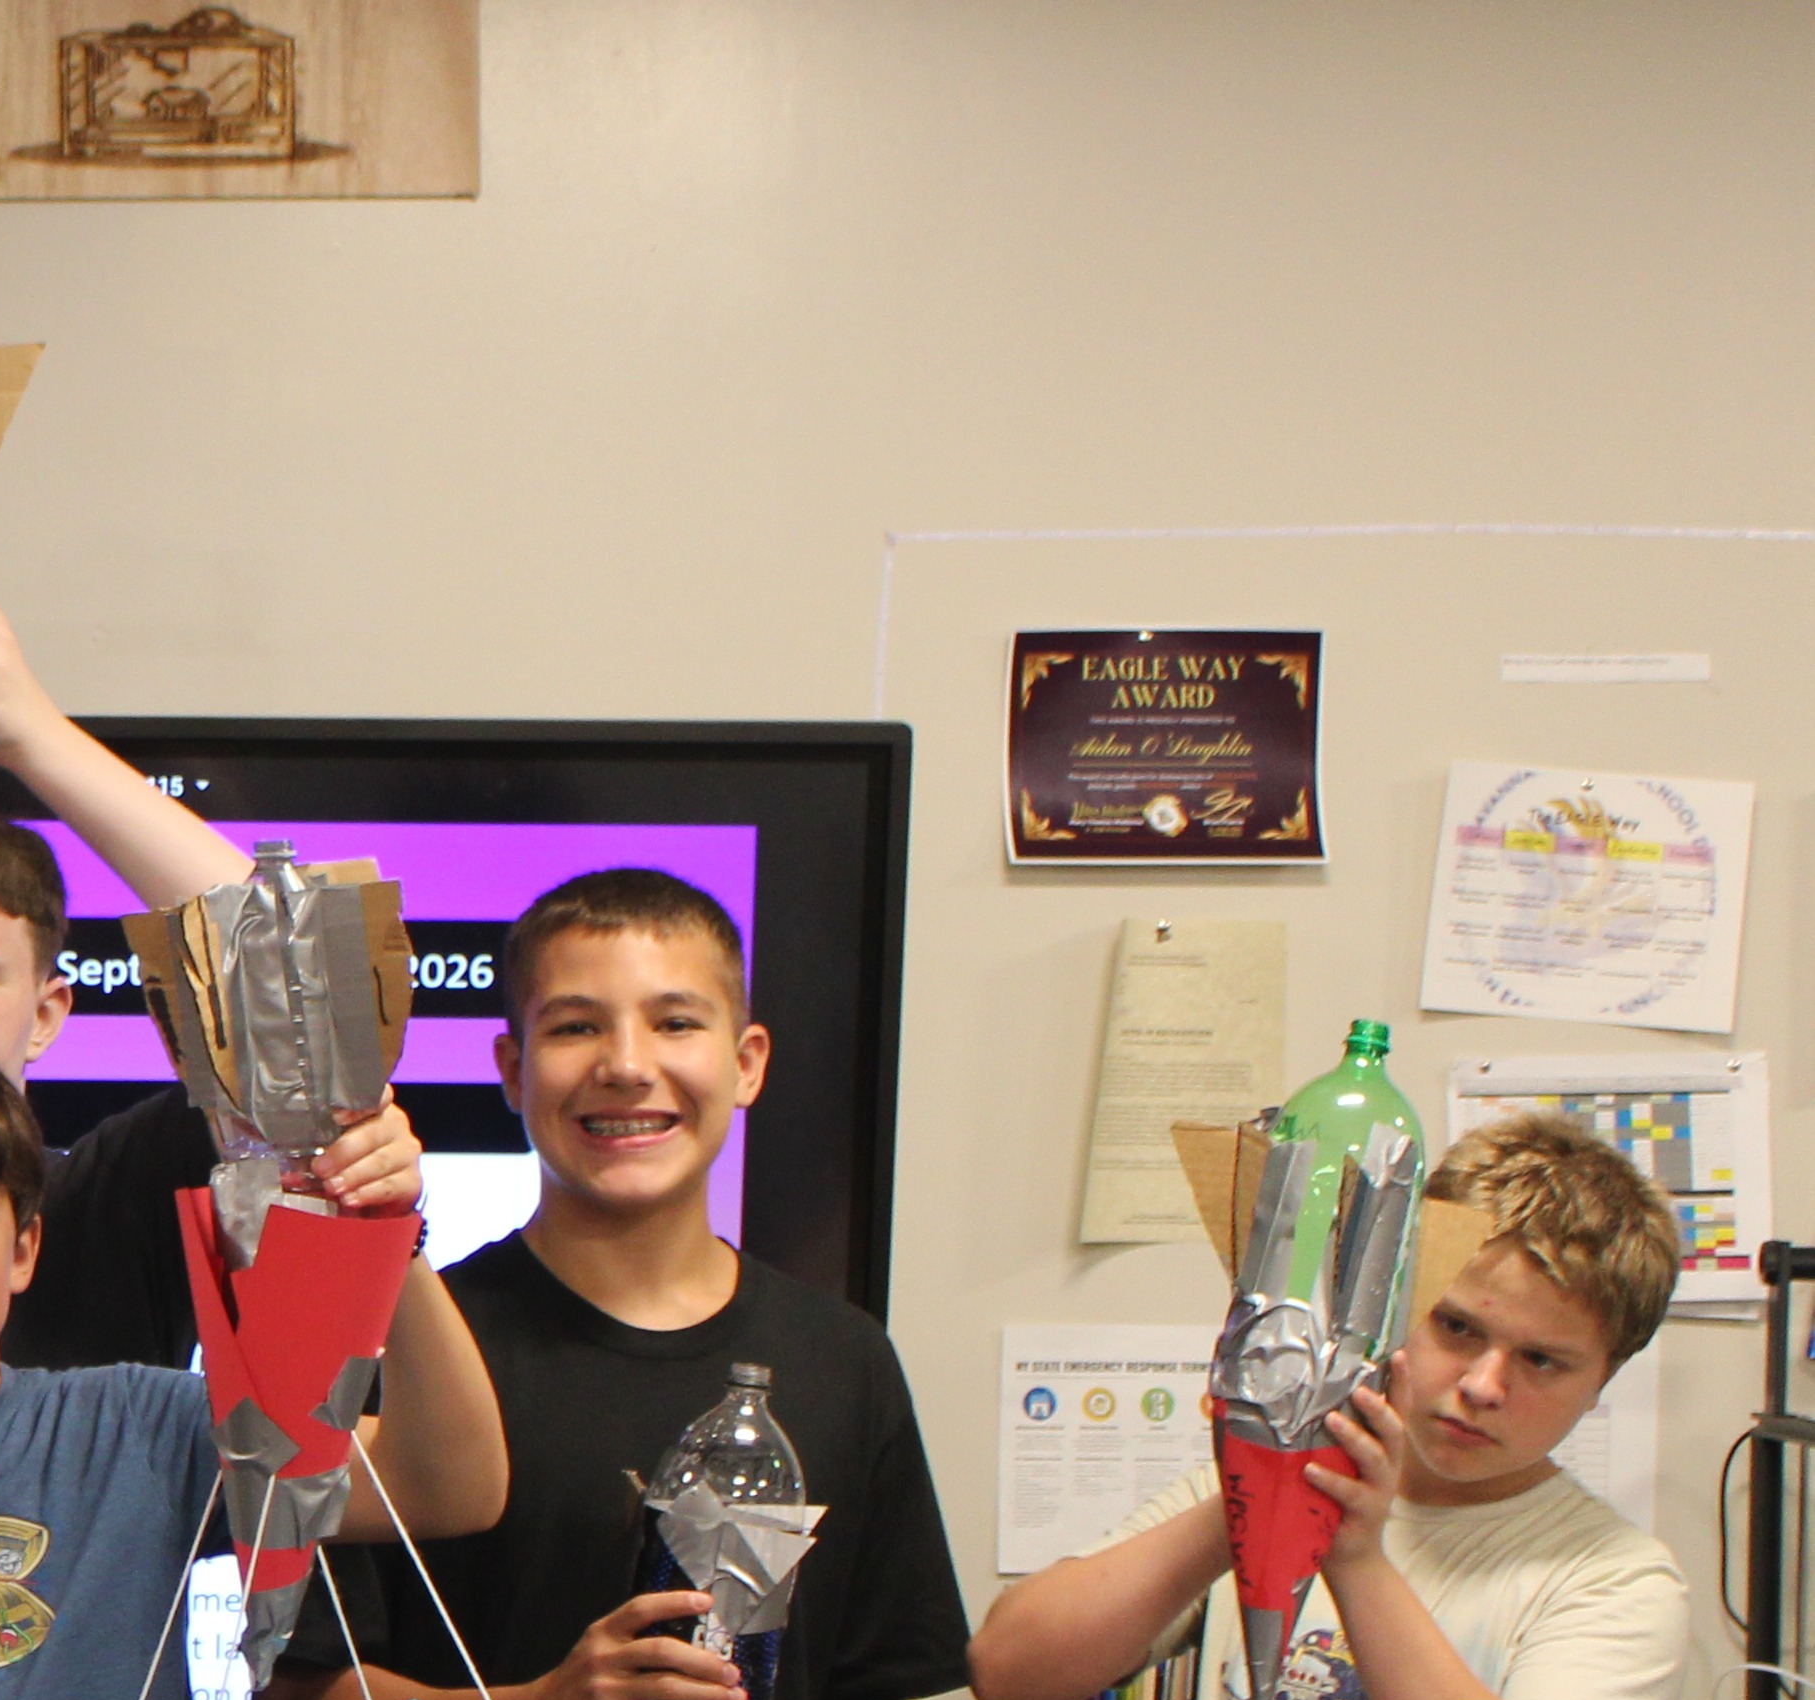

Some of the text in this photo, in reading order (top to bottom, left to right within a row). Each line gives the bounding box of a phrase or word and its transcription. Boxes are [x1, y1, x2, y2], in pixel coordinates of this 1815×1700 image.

[1082, 655, 1246, 682] EAGLE WAY
[1111, 684, 1218, 710] AWARD
